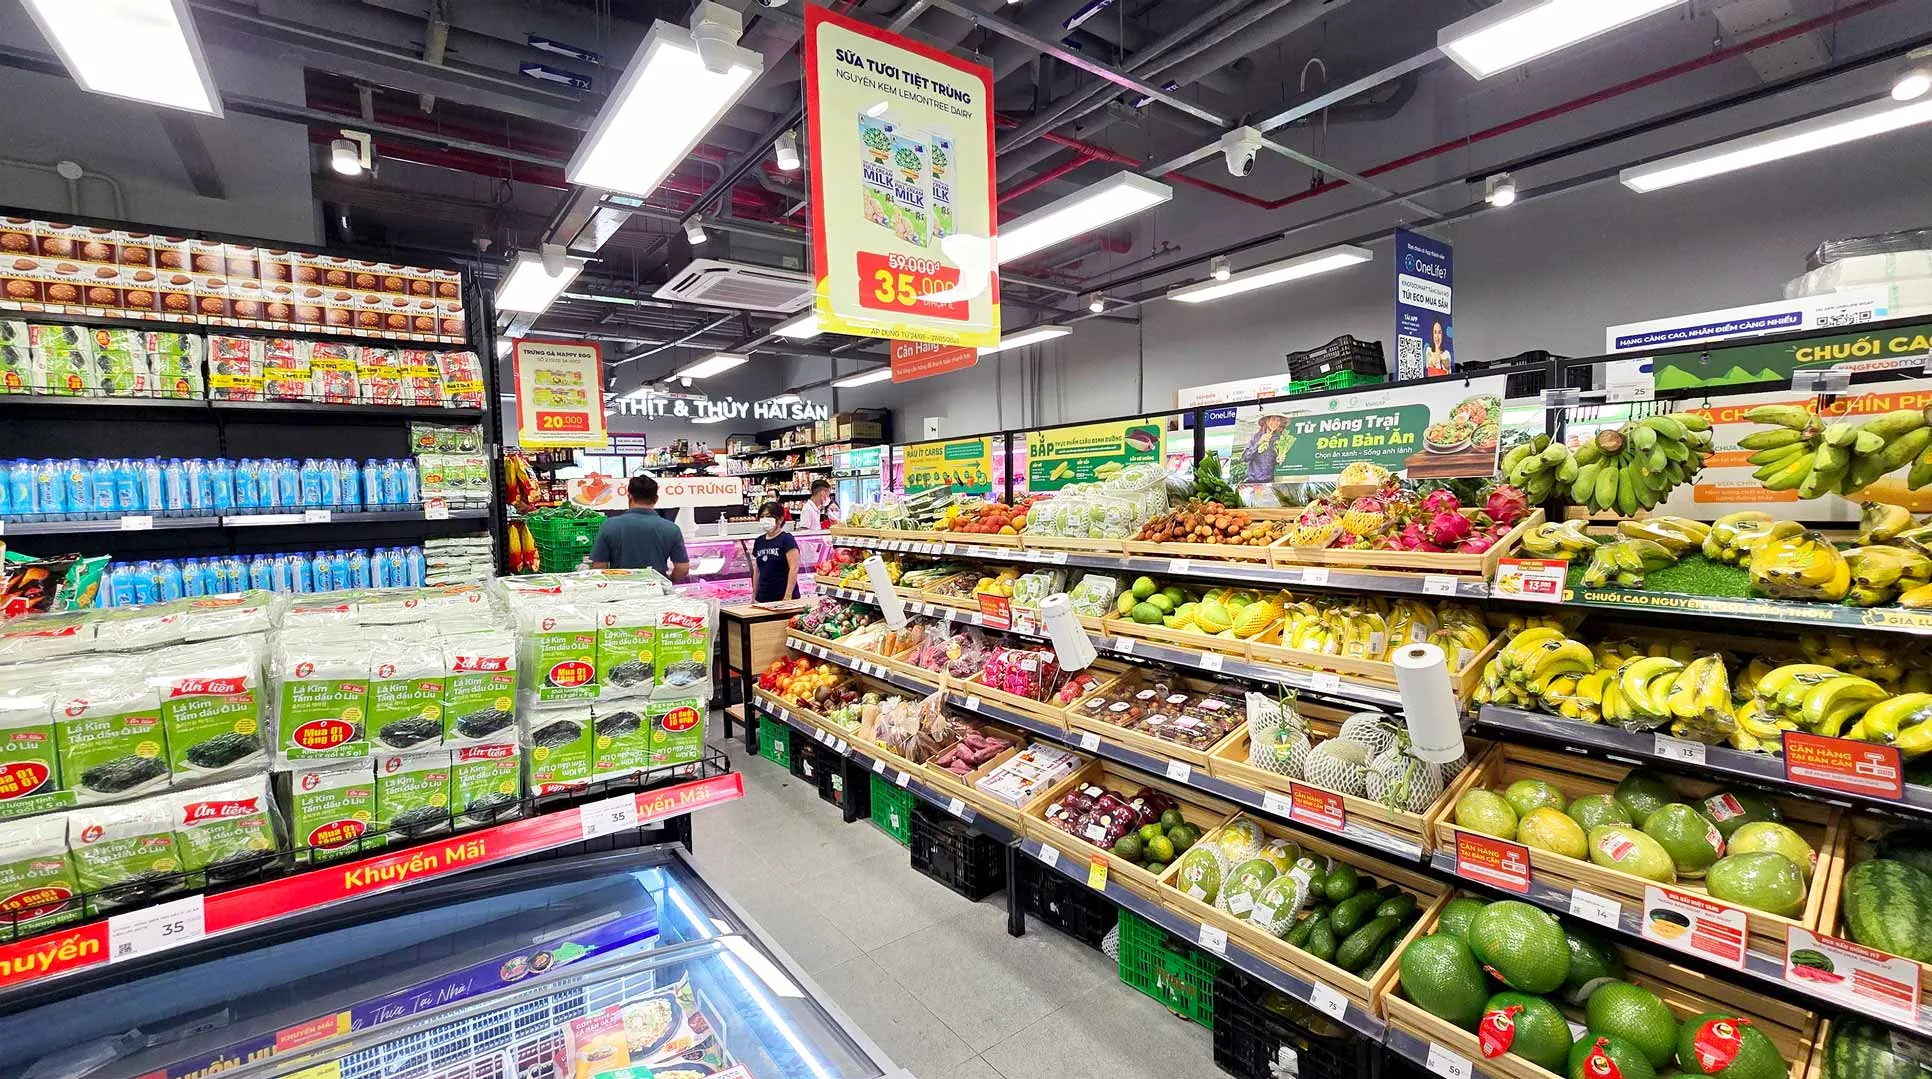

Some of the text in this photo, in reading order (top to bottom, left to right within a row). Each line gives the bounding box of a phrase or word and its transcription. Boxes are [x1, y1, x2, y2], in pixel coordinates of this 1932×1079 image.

[836, 48, 972, 104] SỮA TƯƠI TIỆT TRÙNG
[836, 69, 973, 120] NGUYÊN KEM LEMONTREE DAIRY
[863, 168, 894, 188] MILK
[895, 188, 924, 207] MILK
[1416, 259, 1447, 279] OneLife?
[1644, 332, 1666, 343] CÀNG
[1739, 320, 1766, 331] CÀNG
[1796, 335, 1932, 362] CHUỐI CA
[616, 398, 668, 421] THỊT
[673, 399, 689, 417] &
[694, 396, 749, 419] THỦY
[791, 401, 828, 422] SẢN
[1210, 410, 1236, 420] OneLife
[1295, 413, 1400, 434] Từ Nông Trại
[1316, 428, 1415, 449] Đến Bàn Ăn
[925, 447, 943, 457] CARBS
[665, 481, 737, 496] CÓ TRỨNG!
[1584, 591, 1620, 602] CHUỐI
[1623, 595, 1648, 604] CAO
[576, 667, 587, 675] 01
[576, 674, 587, 682] 01
[293, 684, 328, 694] Lá Kim
[343, 691, 359, 700] Liu
[172, 700, 212, 714] Lá Kim
[231, 703, 248, 713] Liu
[302, 726, 344, 738] Mua 01
[19, 740, 39, 751] Liu
[302, 734, 344, 747] tặng 01
[1682, 748, 1693, 757] 13
[1789, 743, 1814, 755] CÂN
[1816, 746, 1852, 761] HÀNG
[18, 768, 34, 782] 01
[22, 777, 39, 790] 01
[636, 783, 710, 822] uyến Mãi
[612, 810, 626, 824] 35
[318, 828, 343, 841] Mua
[344, 839, 486, 889] Khuyến Mãi
[162, 921, 185, 937] 35
